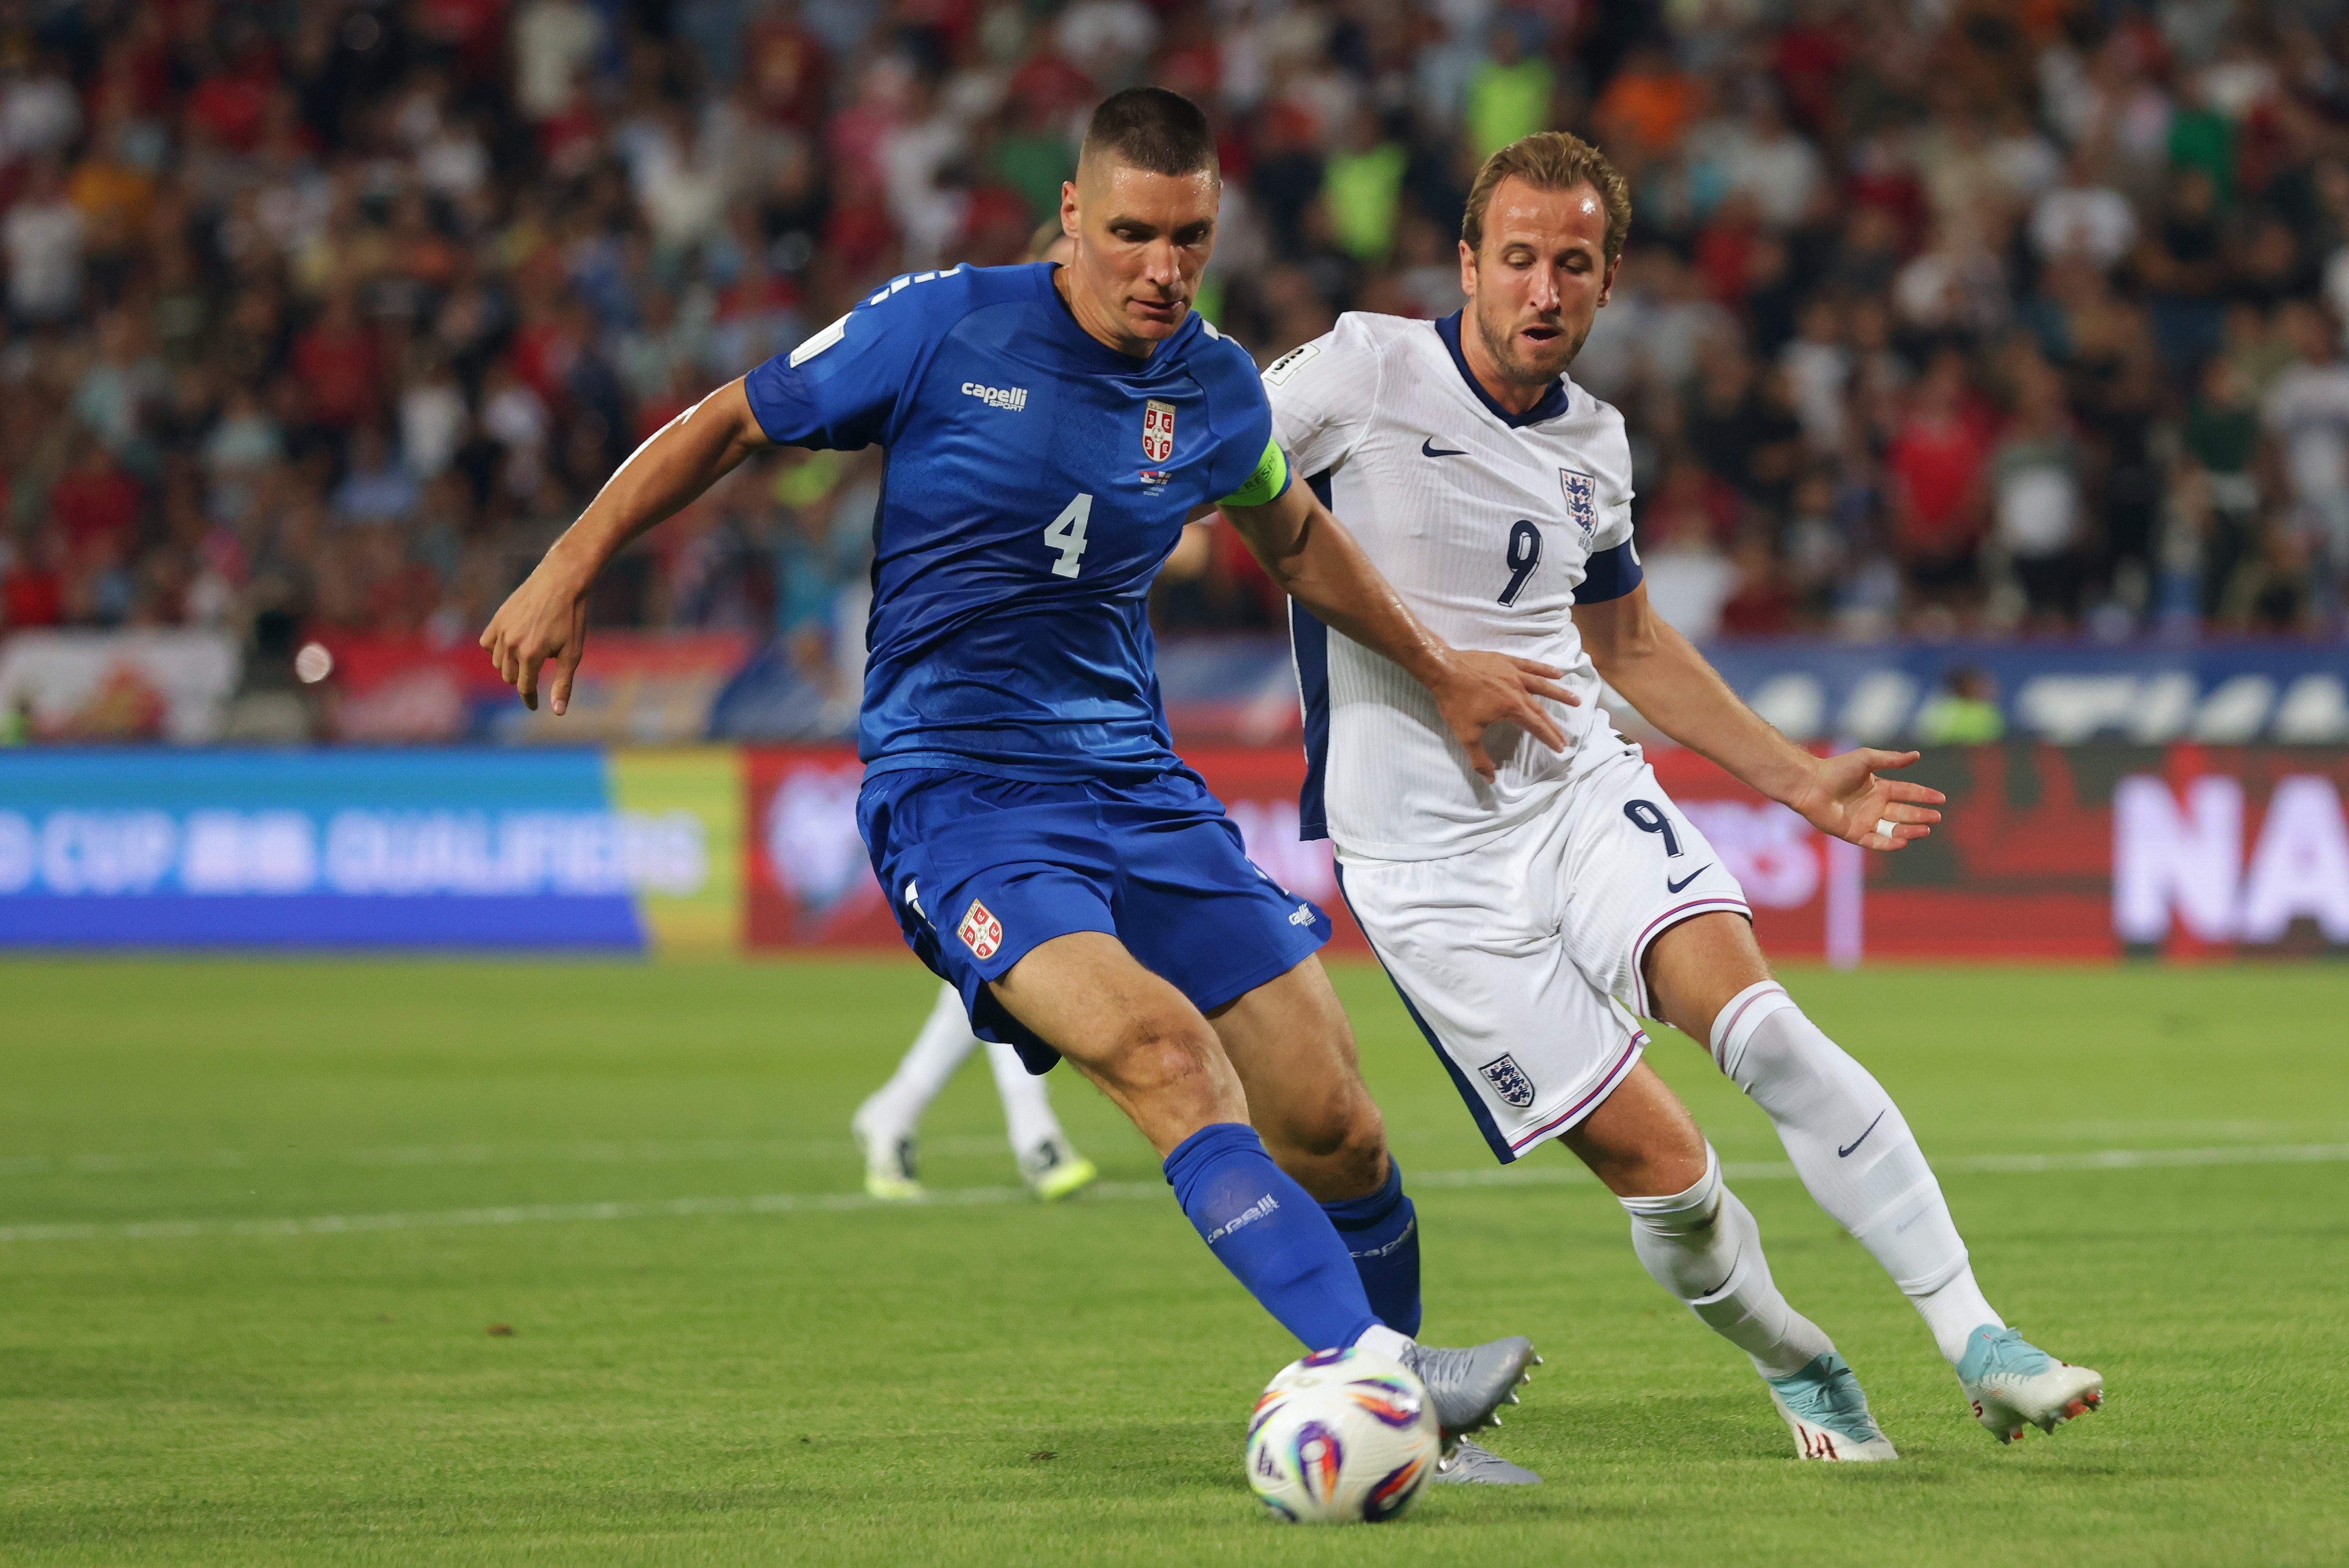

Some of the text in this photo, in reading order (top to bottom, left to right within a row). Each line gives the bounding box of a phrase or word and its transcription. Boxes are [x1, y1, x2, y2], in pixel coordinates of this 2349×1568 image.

[961, 382, 1028, 406] capelli
[989, 400, 1025, 412] SPORT
[1044, 492, 1093, 579] 4
[1497, 520, 1543, 607] 9
[1623, 799, 1684, 858] 9
[2113, 775, 2349, 944] NA
